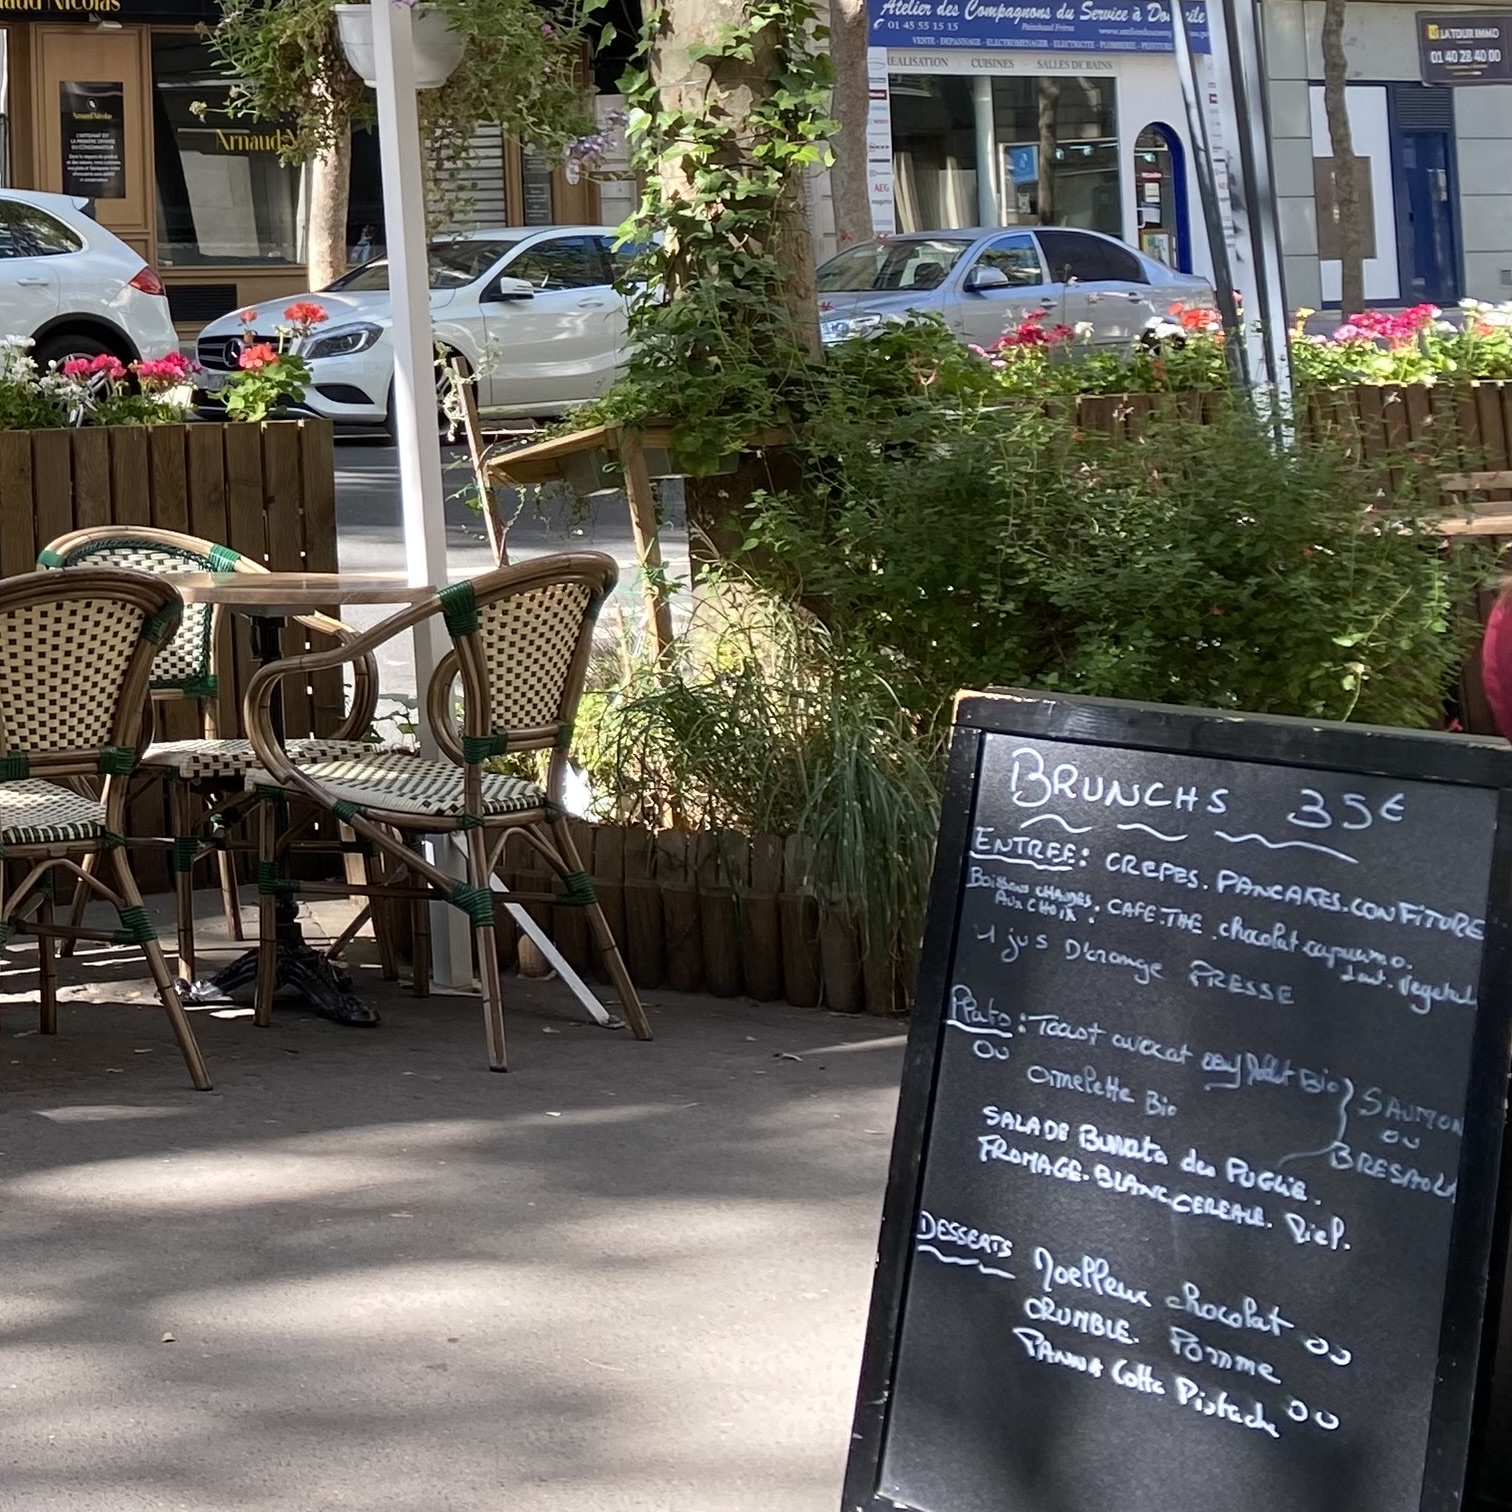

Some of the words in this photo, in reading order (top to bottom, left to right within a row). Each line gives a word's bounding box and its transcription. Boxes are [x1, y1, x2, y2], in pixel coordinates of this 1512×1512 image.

[1056, 2, 1076, 20] du
[1079, 0, 1129, 22] Service
[1131, 6, 1143, 22] à
[888, 20, 900, 30] 01
[903, 21, 915, 30] 45
[917, 21, 930, 31] 55
[932, 21, 944, 31] 15
[947, 22, 959, 31] 15
[1450, 28, 1474, 39] TOUR
[1474, 27, 1500, 39] IMMO
[912, 36, 936, 45] VENTE
[1430, 50, 1444, 63] 01
[1445, 49, 1458, 63] 40
[971, 58, 1015, 69] CUISINES
[1037, 59, 1071, 70] SALLES
[874, 183, 890, 192] AEG
[1011, 746, 1229, 814] BRUNCHS
[1287, 789, 1404, 829] 35€
